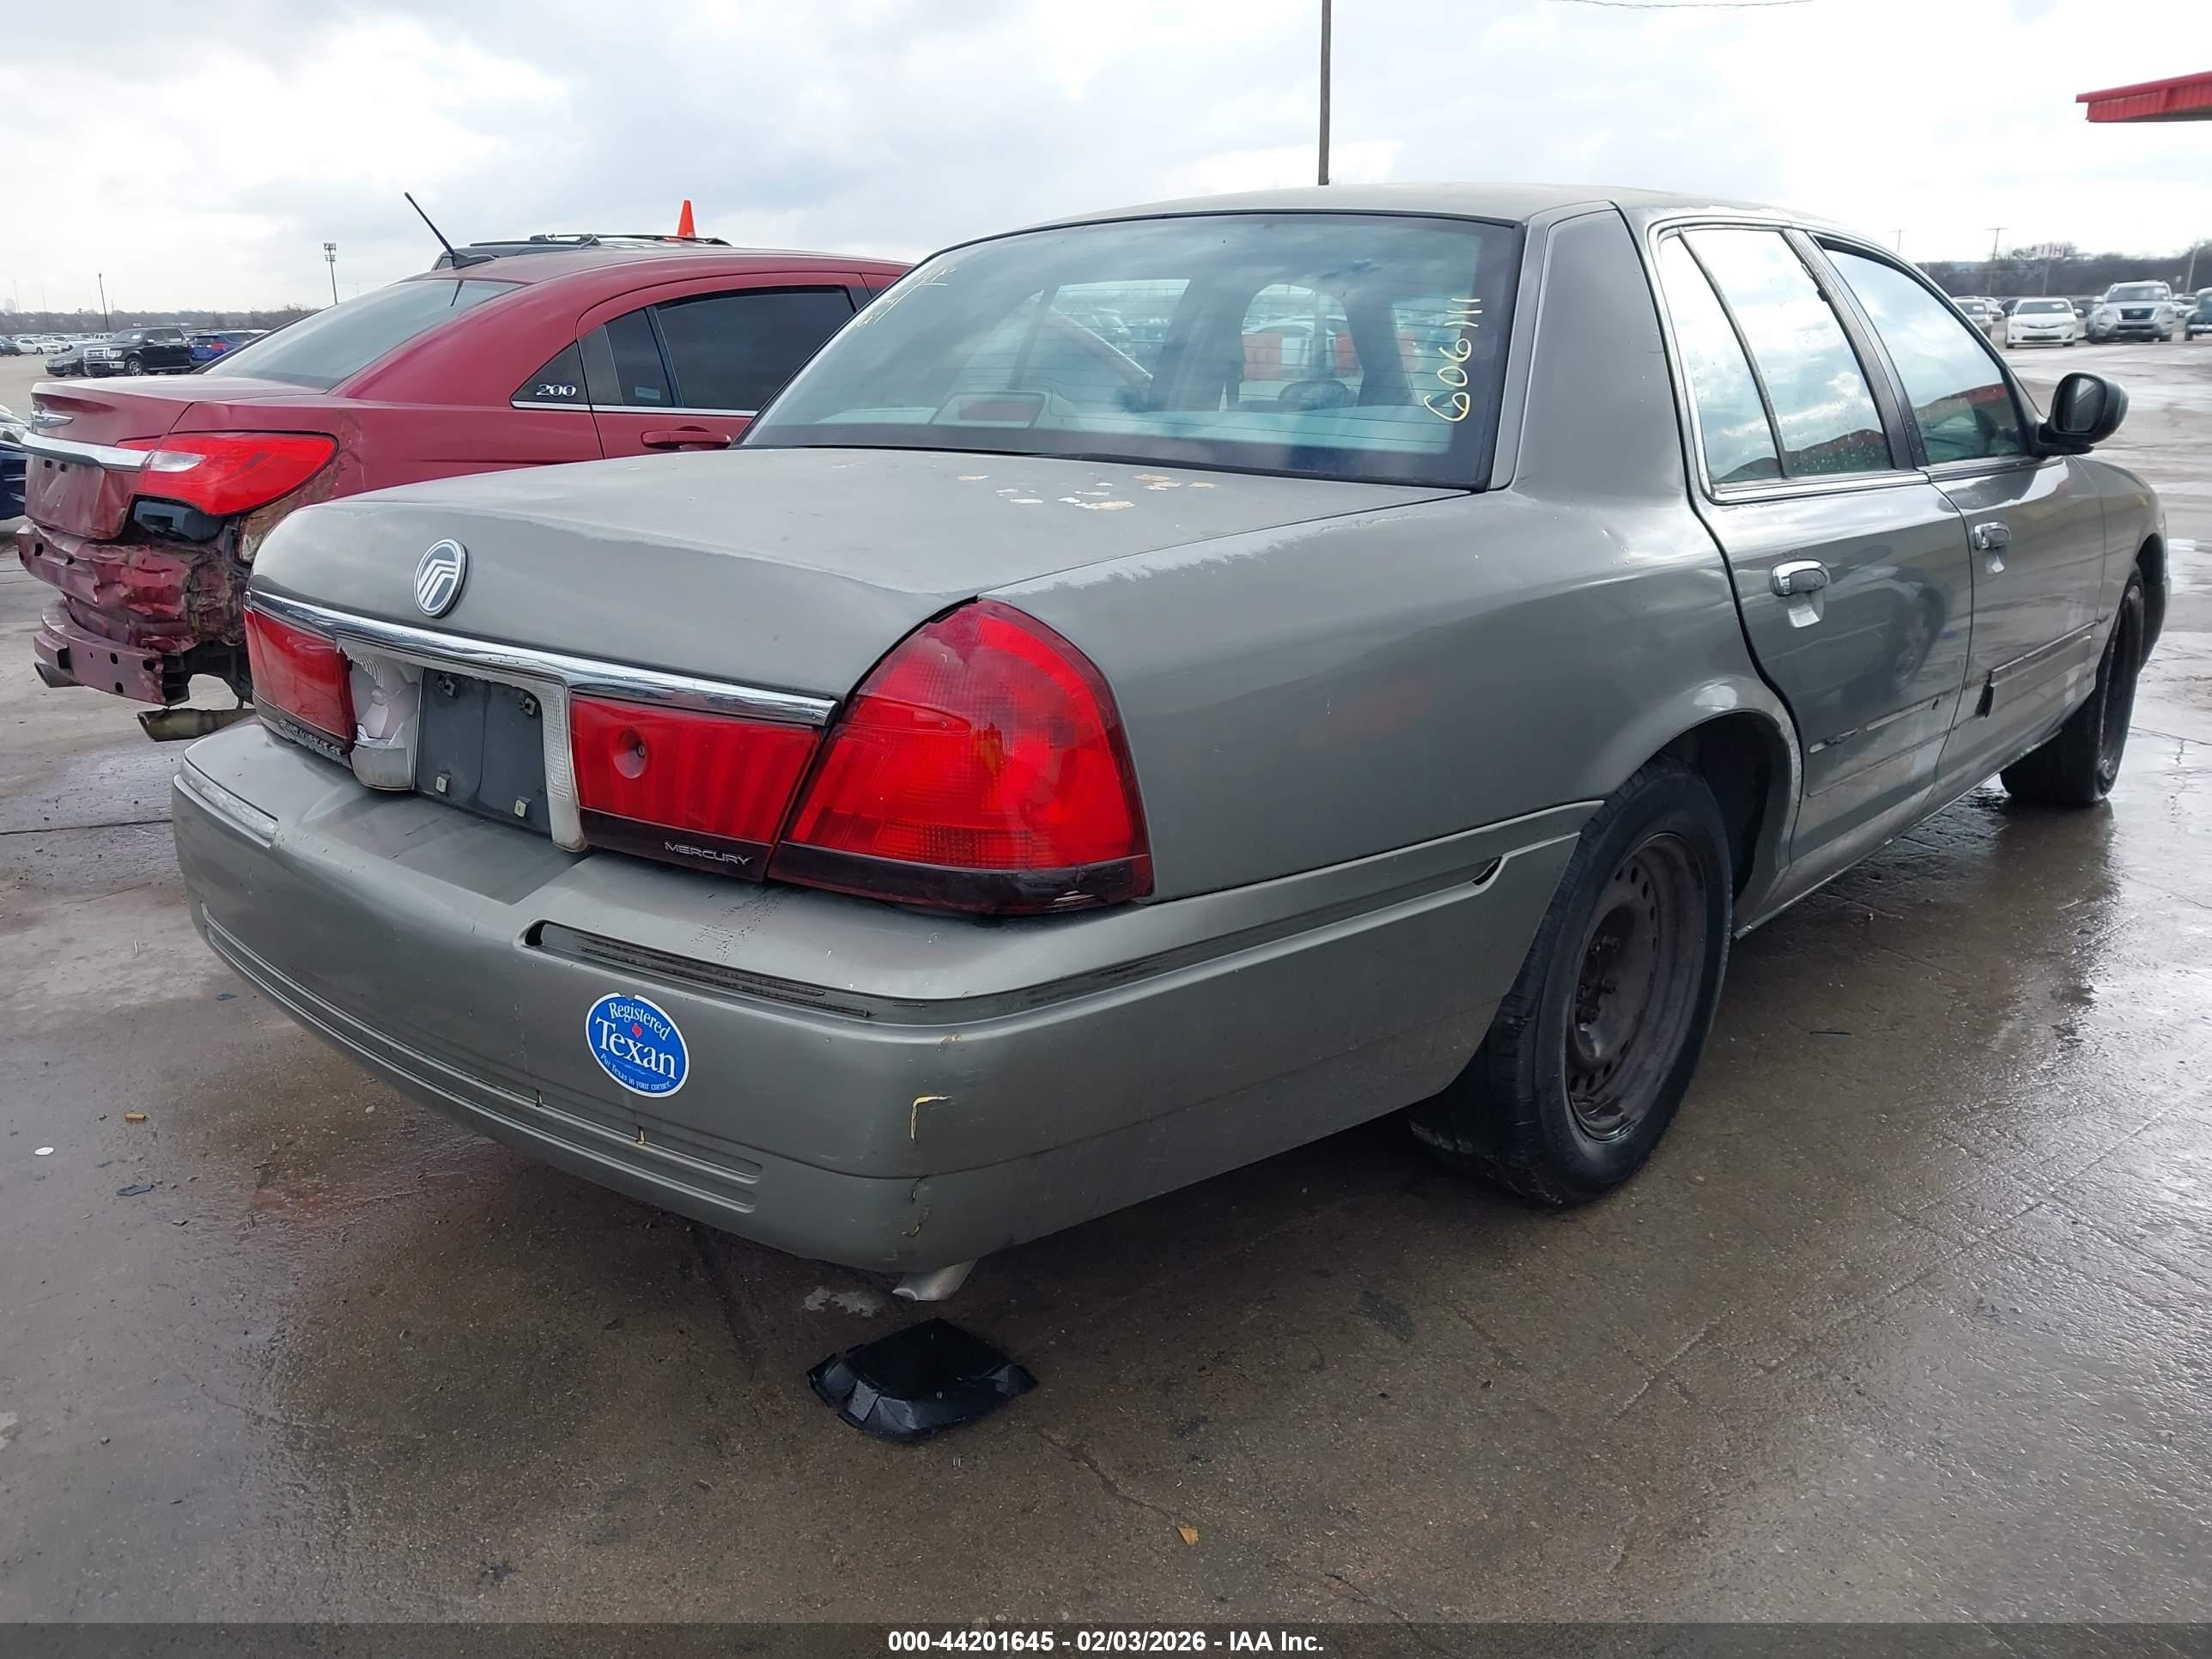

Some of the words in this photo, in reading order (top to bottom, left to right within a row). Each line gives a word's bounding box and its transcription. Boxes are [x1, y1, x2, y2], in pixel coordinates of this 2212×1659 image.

[536, 384, 577, 397] 200
[664, 842, 753, 866] MERCURY
[608, 1001, 672, 1042] Registered
[595, 1016, 677, 1080] Texan
[611, 1064, 628, 1081] Texas
[629, 1075, 635, 1085] in
[635, 1080, 649, 1090] your
